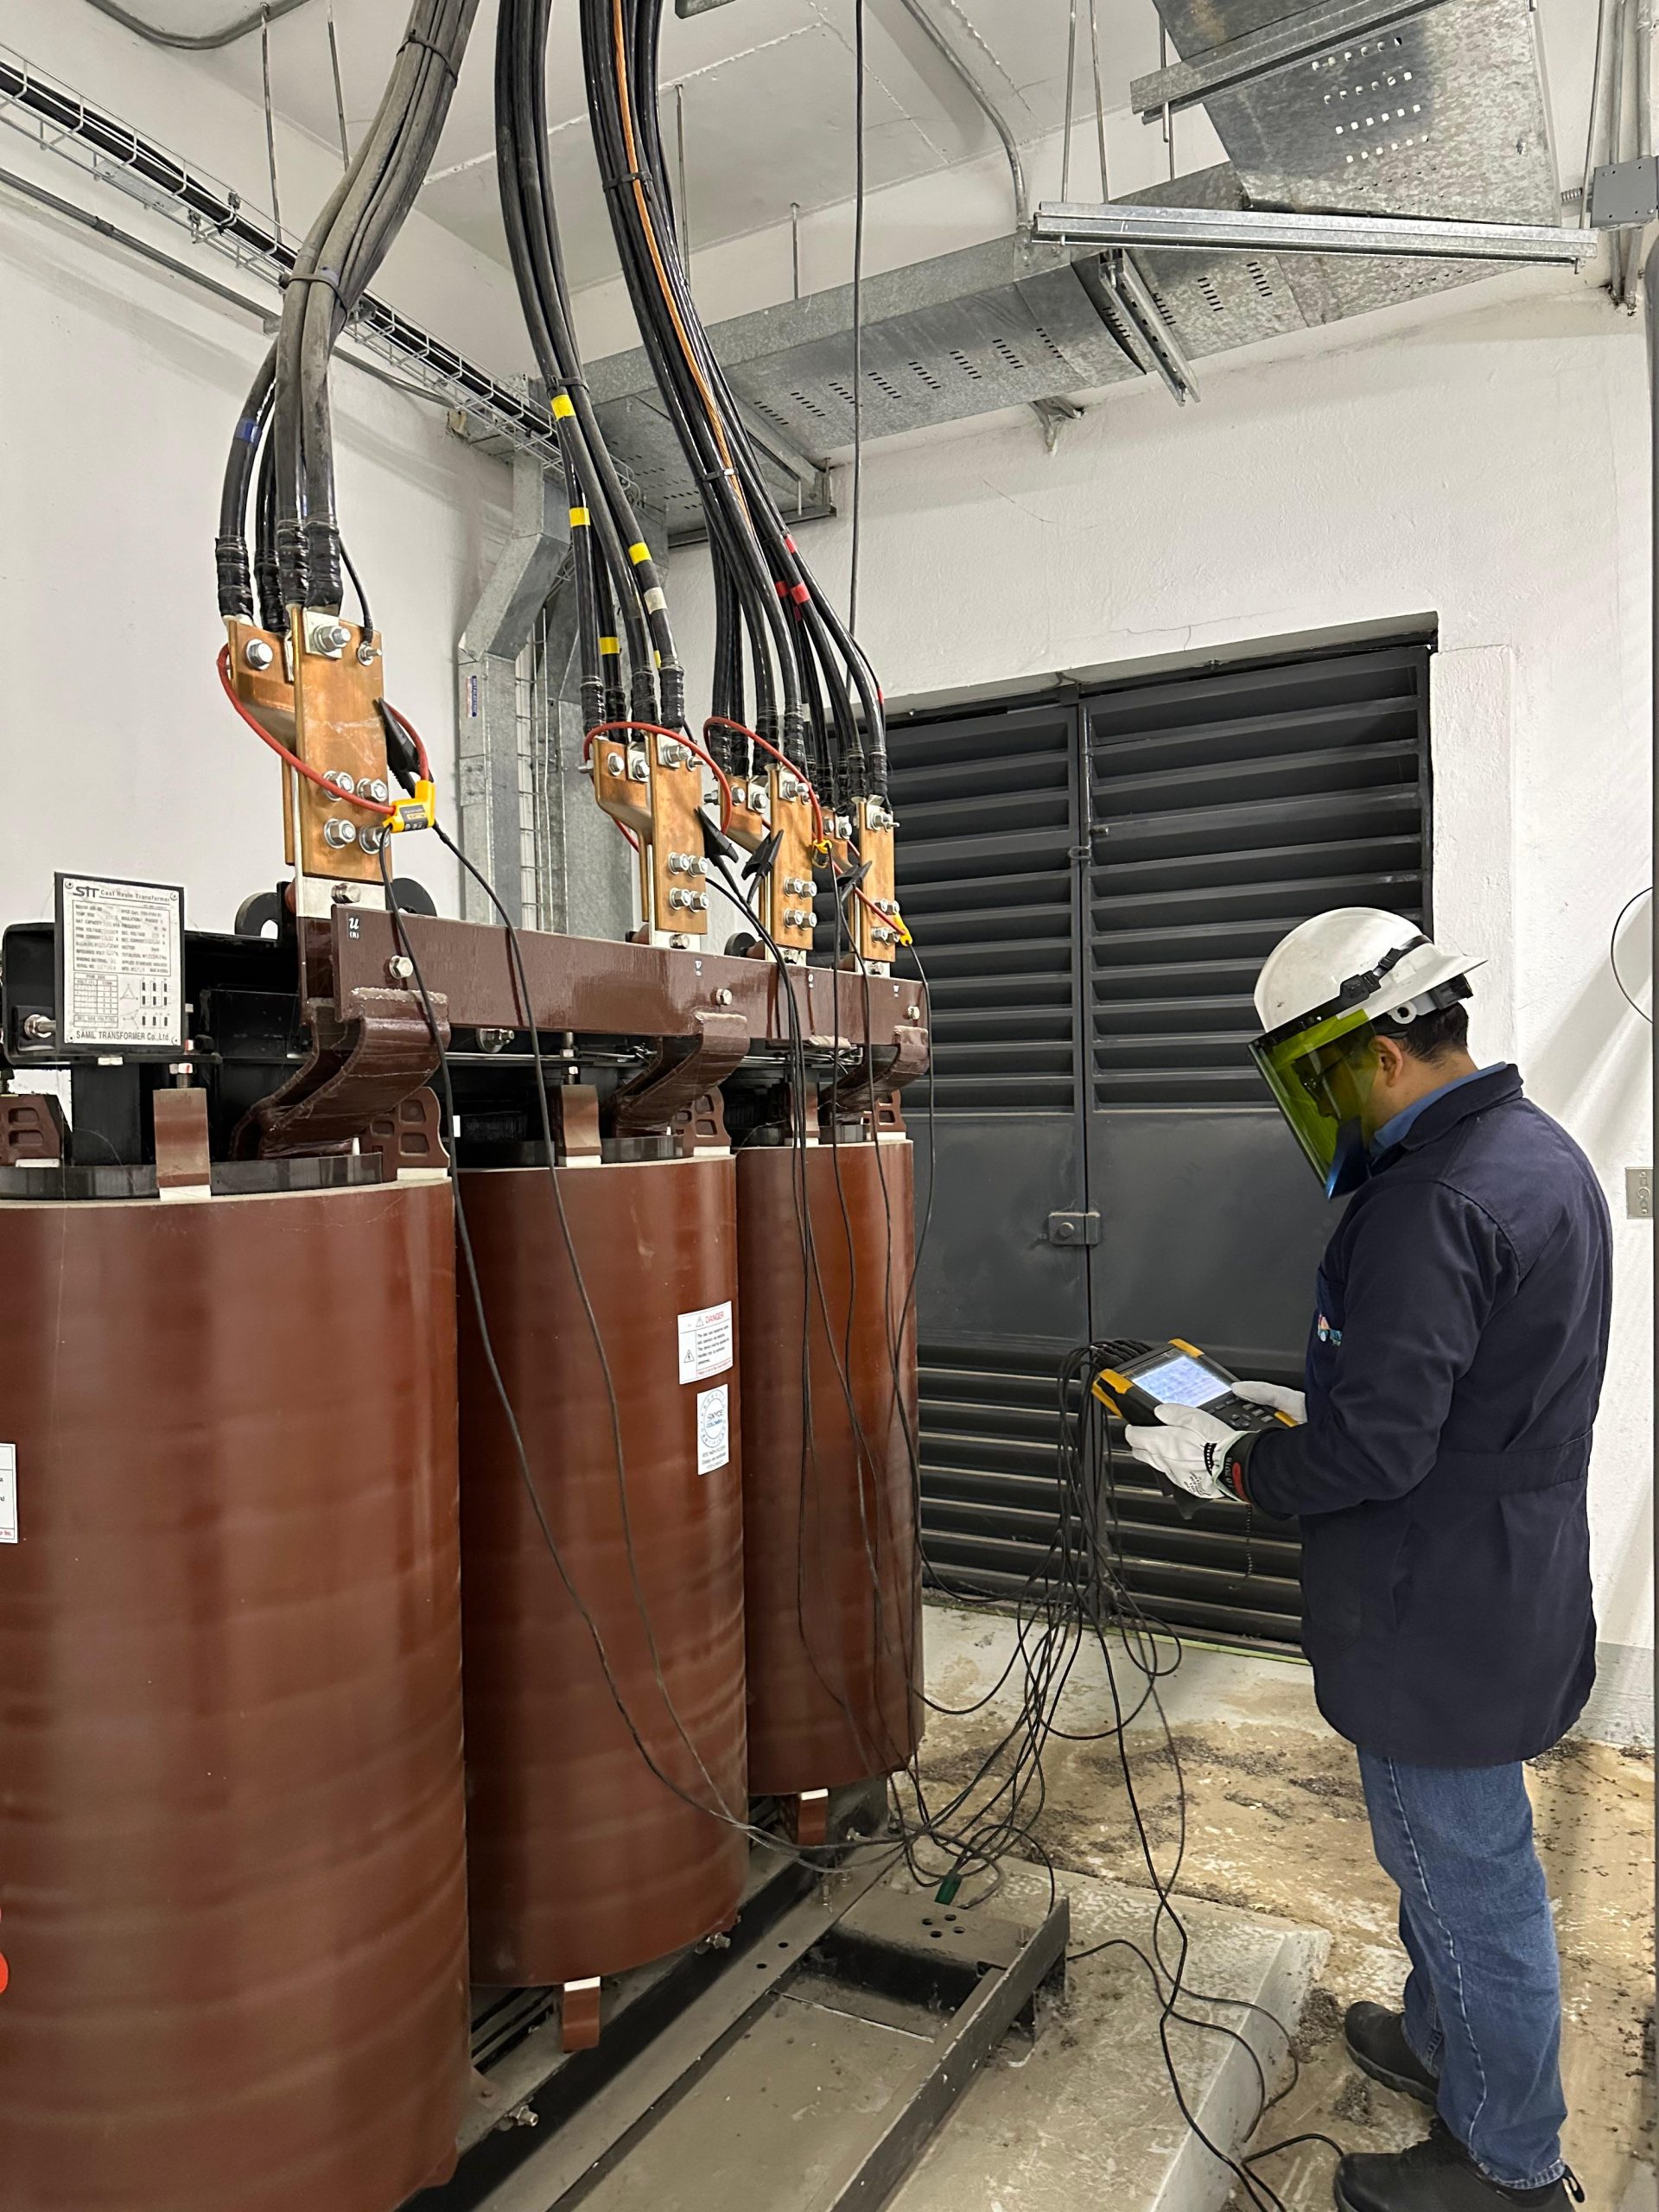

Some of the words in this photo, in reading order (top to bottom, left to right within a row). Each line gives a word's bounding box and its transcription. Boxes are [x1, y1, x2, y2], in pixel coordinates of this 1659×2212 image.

[135, 893, 170, 902] Transformer
[76, 1031, 95, 1039] SAMIL
[99, 1031, 145, 1040] TRANSFORMER
[705, 1311, 724, 1323] DANGER
